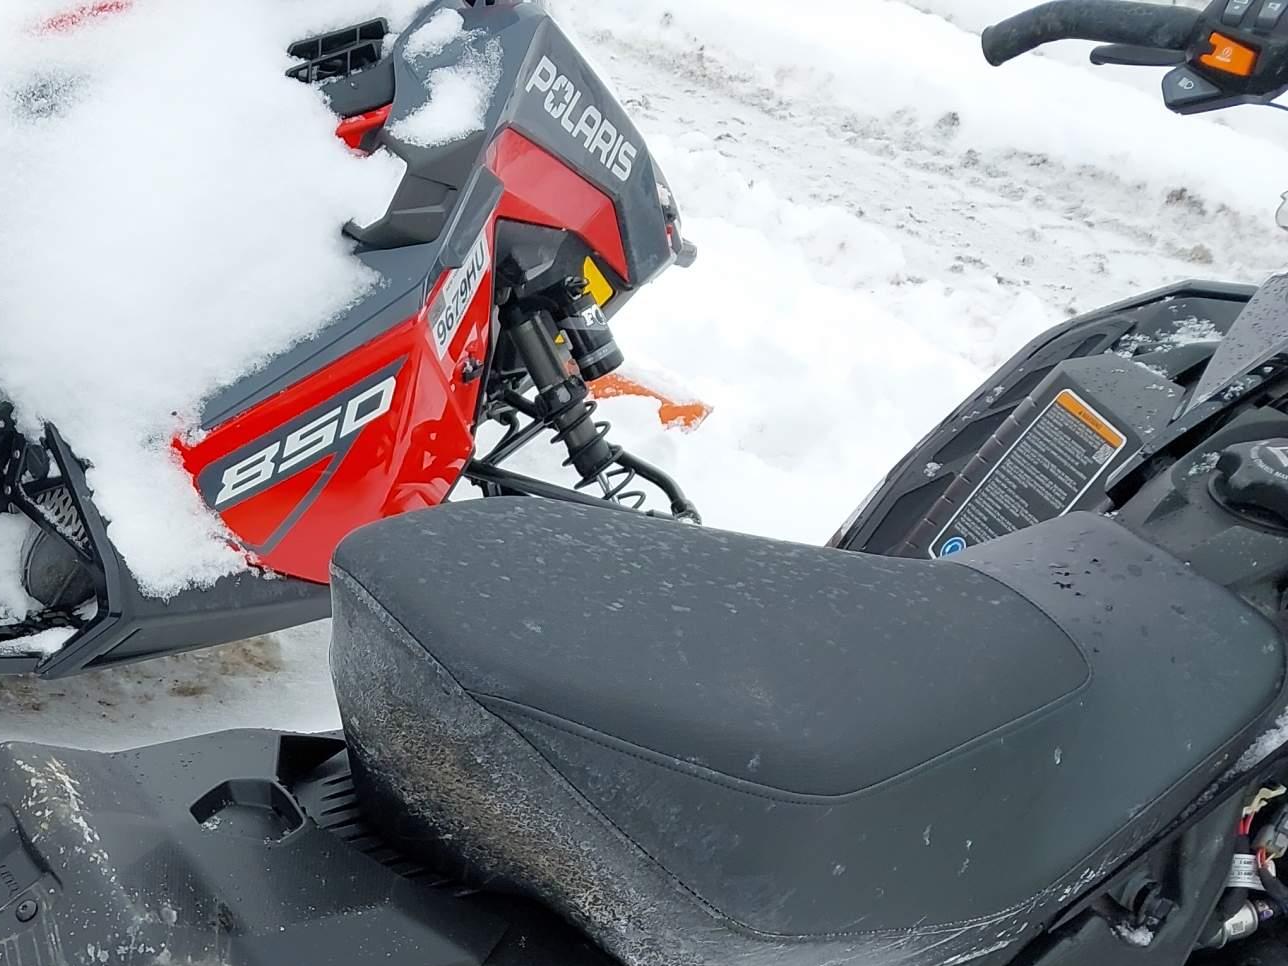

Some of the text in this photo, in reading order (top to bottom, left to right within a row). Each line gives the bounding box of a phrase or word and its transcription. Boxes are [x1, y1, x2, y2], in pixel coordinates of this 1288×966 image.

[525, 55, 637, 182] POLARIS
[436, 241, 485, 346] 9679HU
[215, 376, 397, 505] 850
